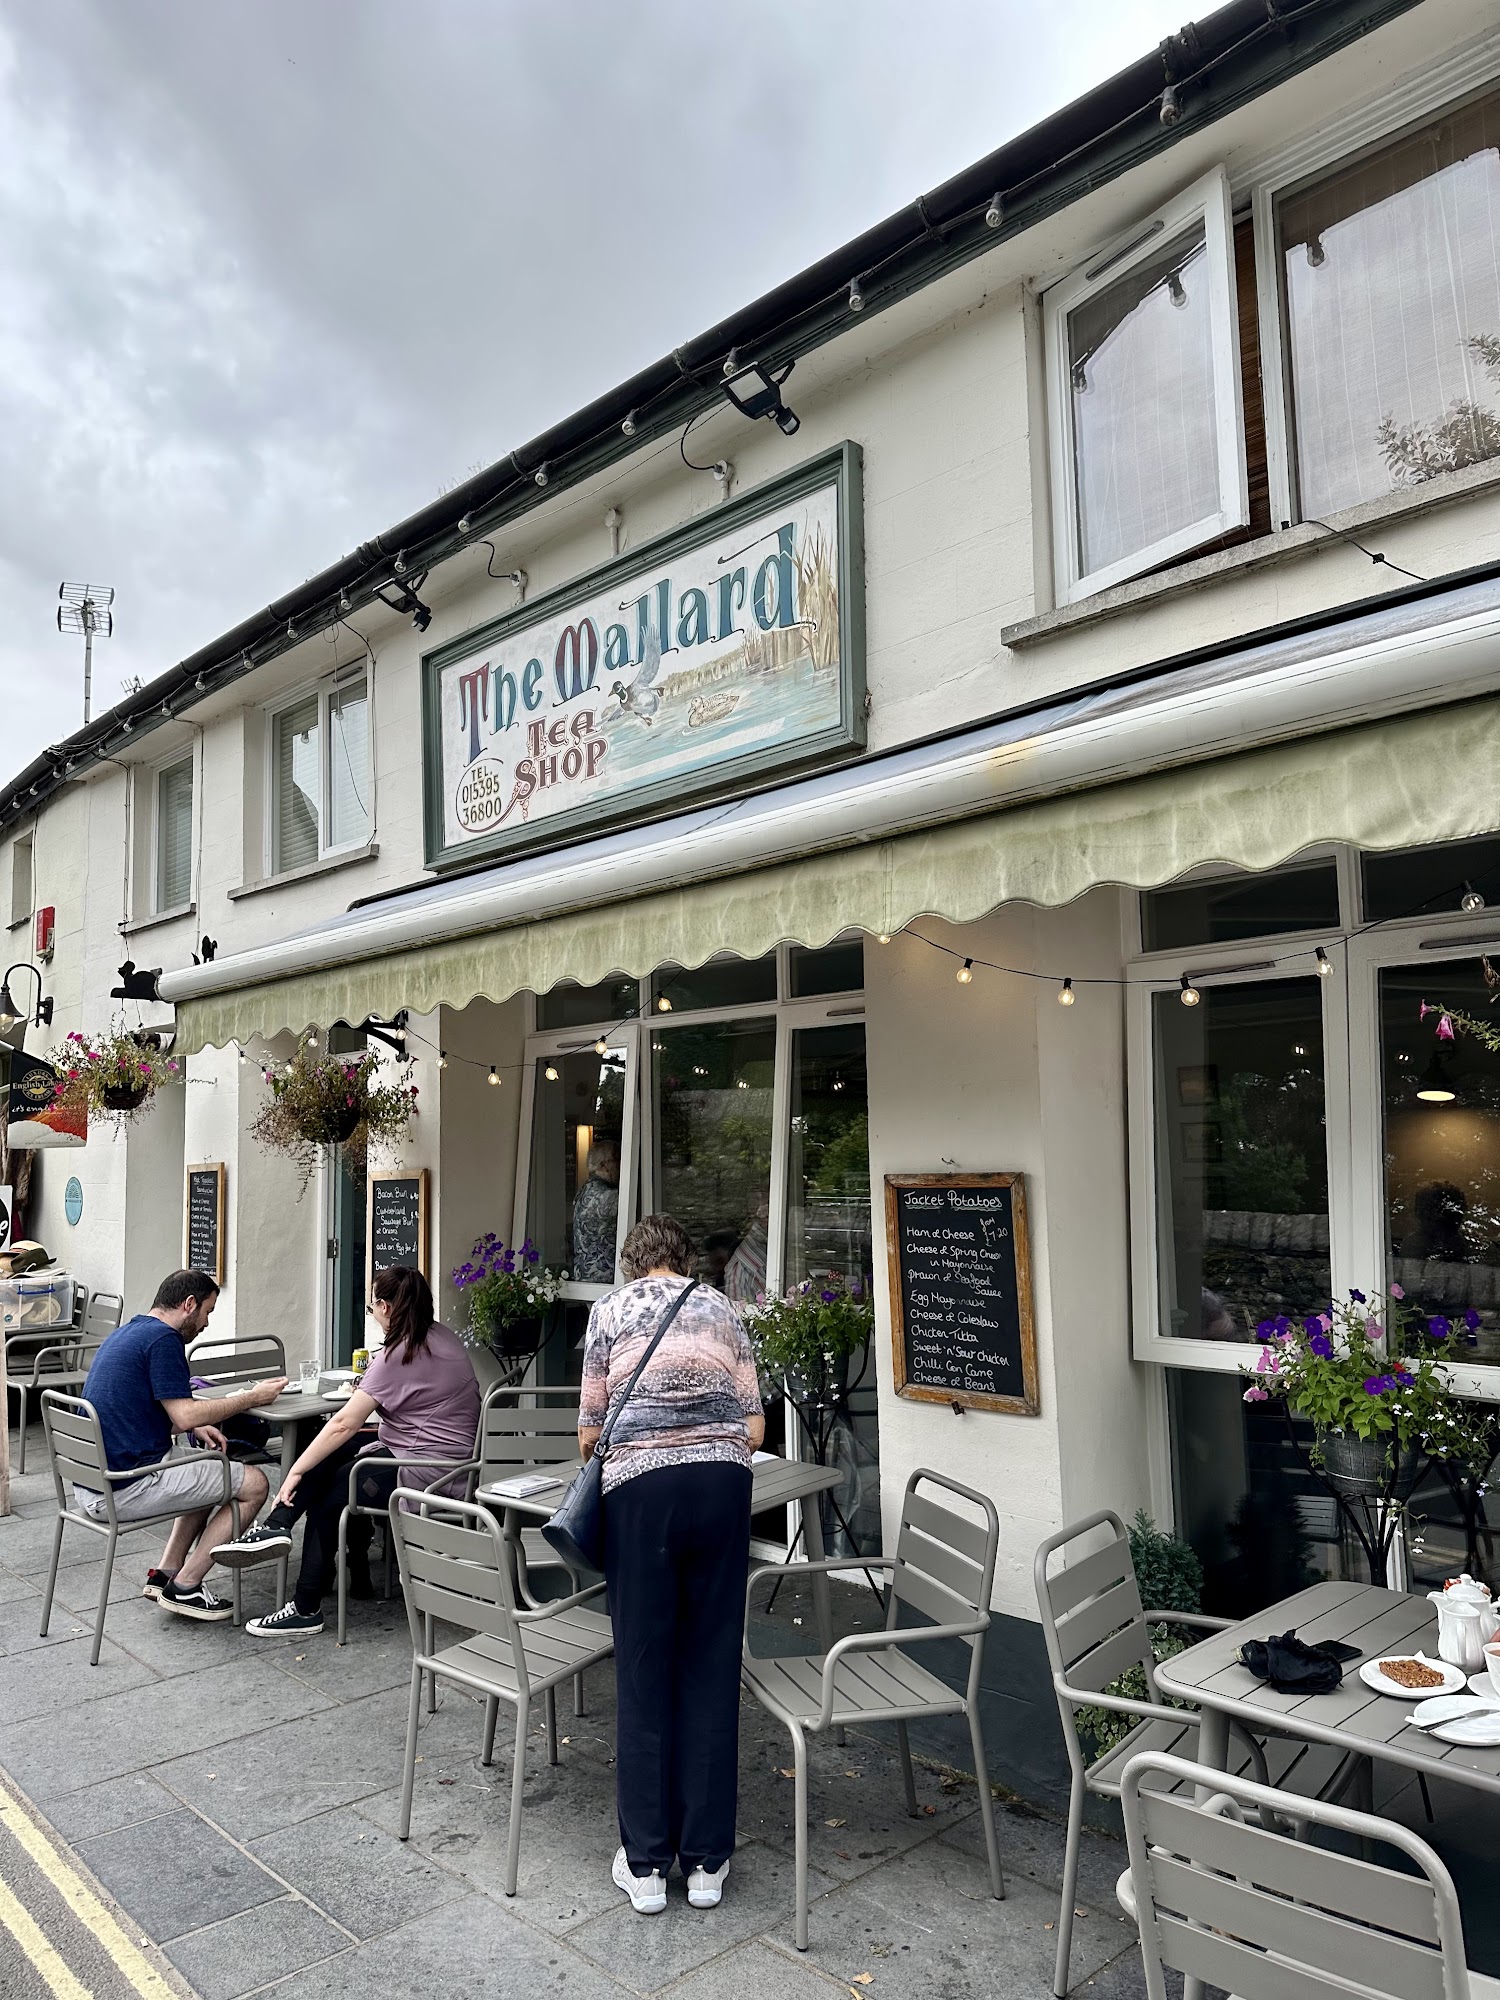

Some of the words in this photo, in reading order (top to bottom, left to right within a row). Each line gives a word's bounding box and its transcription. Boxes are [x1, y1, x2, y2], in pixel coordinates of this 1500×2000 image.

[458, 657, 544, 768] The
[552, 522, 817, 708] Mallard
[471, 766, 493, 781] TEL.
[513, 738, 608, 802] SHOP
[462, 774, 500, 804] 015395
[462, 797, 502, 826] 36800
[12, 1080, 40, 1091] English
[376, 1187, 394, 1199] Bacon
[395, 1187, 409, 1199] Bun
[904, 1191, 945, 1206] Jacket
[947, 1190, 1003, 1208] Potatoes
[402, 1216, 414, 1226] Bun
[906, 1226, 931, 1238] Ham
[942, 1228, 975, 1241] Cheese
[906, 1243, 939, 1255] Cheese
[950, 1245, 978, 1263] Spring
[942, 1259, 996, 1273] Mayonnaise
[907, 1269, 941, 1284] Prawn
[954, 1272, 992, 1288] Seafood
[910, 1289, 929, 1308] Egg
[974, 1285, 1003, 1298] Sauce
[910, 1308, 943, 1321] Cheese
[958, 1311, 999, 1328] Coleslaw
[911, 1324, 949, 1338] Chicken
[949, 1328, 979, 1342] Tikka
[913, 1340, 942, 1354] Sweet
[955, 1346, 977, 1359] Sour
[356, 1359, 368, 1369] FAN
[914, 1356, 944, 1370] Chilli
[946, 1360, 963, 1373] Con
[965, 1363, 994, 1379] Carne
[913, 1371, 948, 1386] Cheese
[964, 1377, 996, 1392] Beans
